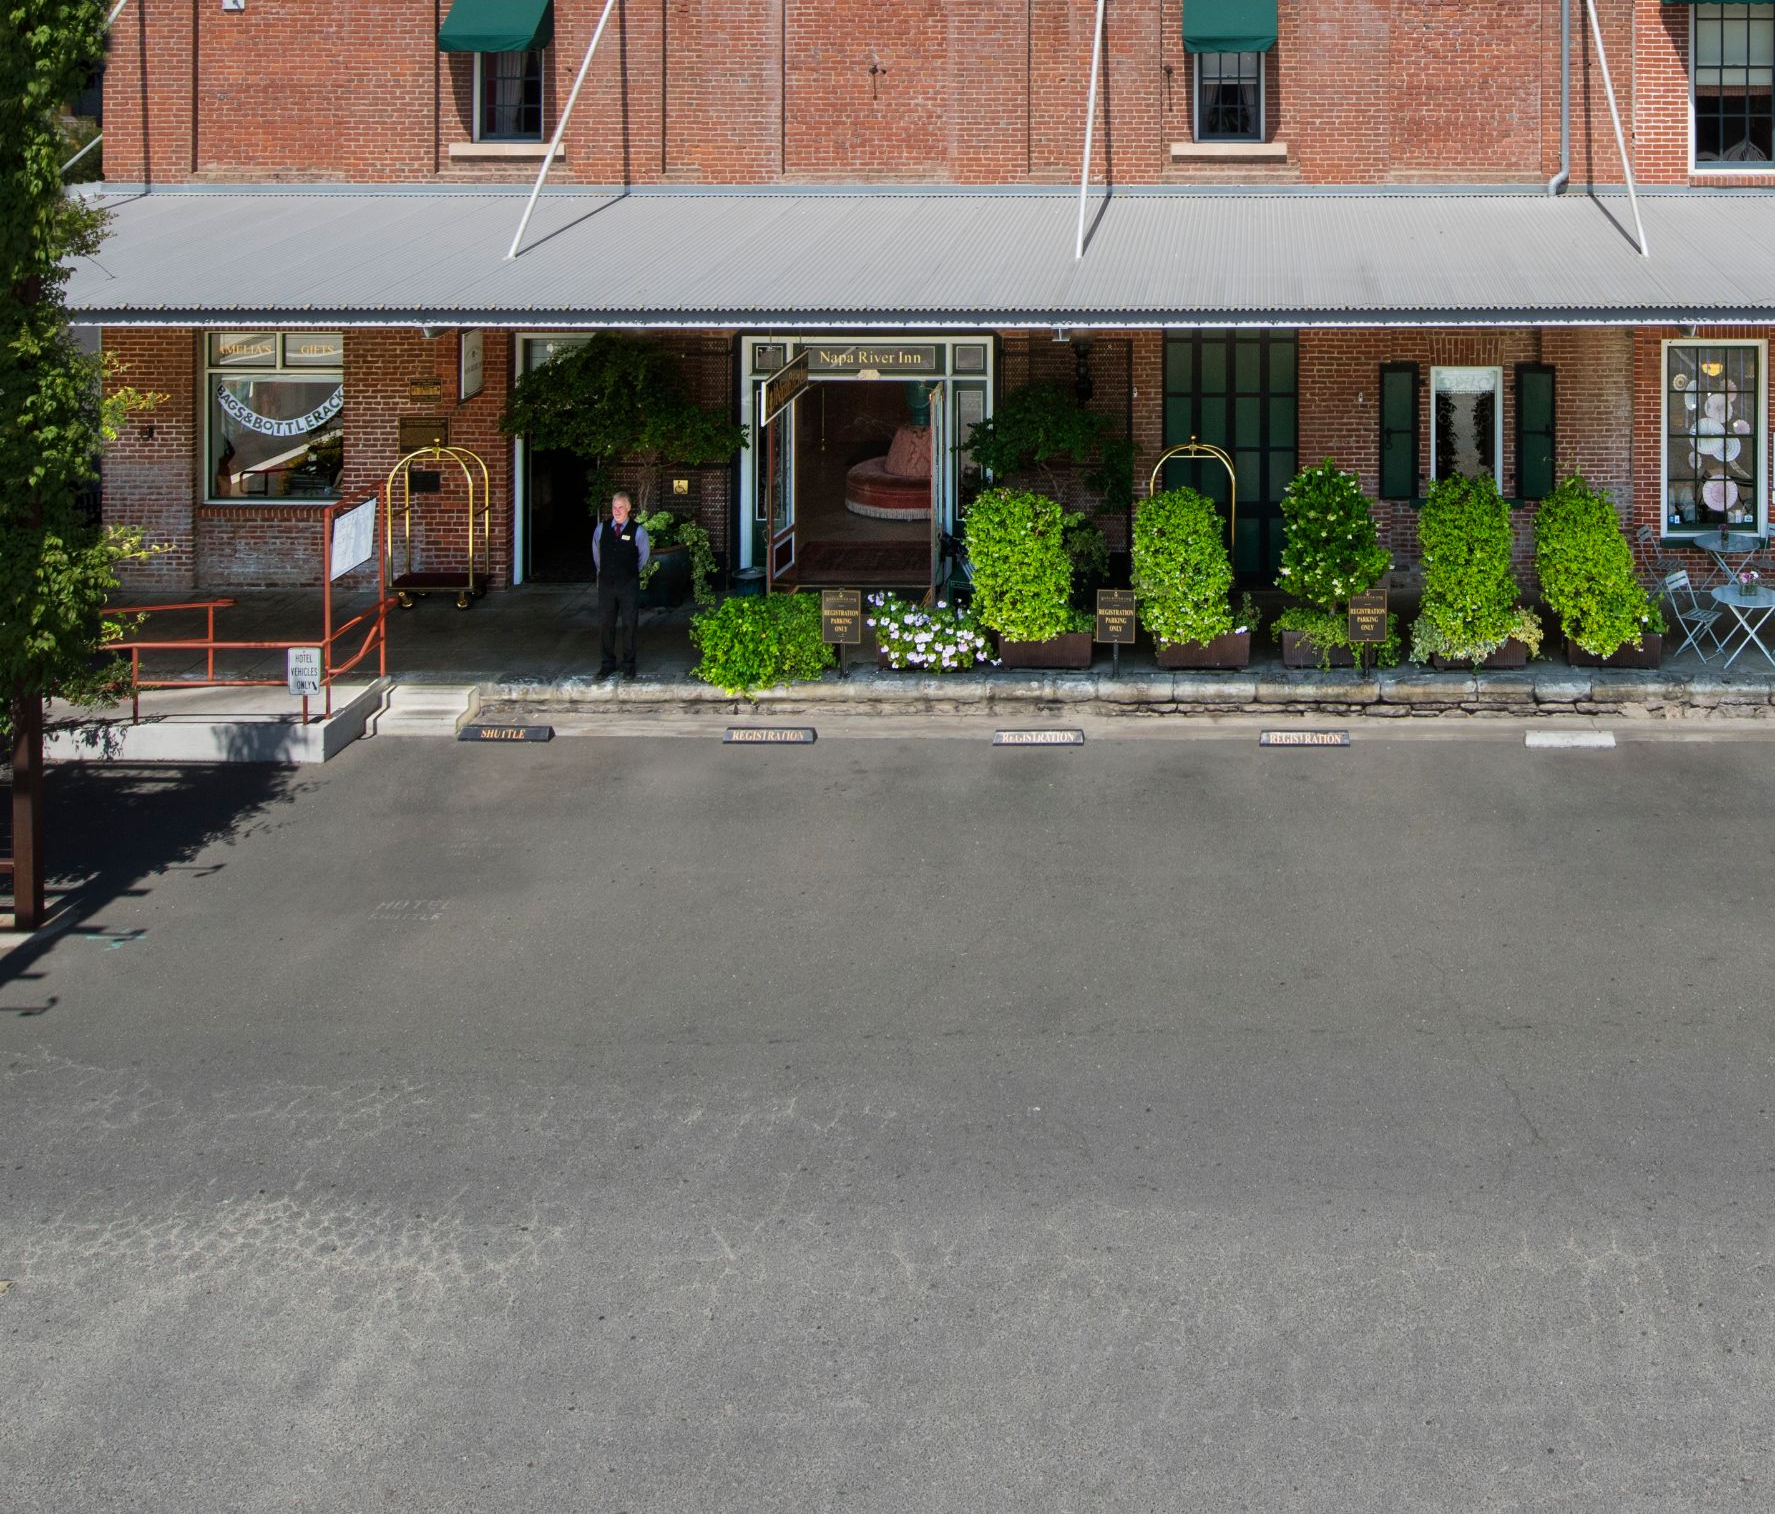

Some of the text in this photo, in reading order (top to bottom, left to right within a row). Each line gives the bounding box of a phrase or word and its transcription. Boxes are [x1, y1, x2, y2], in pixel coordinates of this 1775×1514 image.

[300, 344, 335, 355] GIFTS
[820, 351, 921, 367] Napa River Inn
[295, 654, 313, 663] HOTEL
[290, 667, 318, 676] VEHICLES
[296, 681, 313, 690] ONLY
[480, 728, 526, 739] SHUTTLE
[732, 730, 805, 741] REGISTRATION
[1002, 731, 1075, 743] REGISTRATION
[1269, 733, 1342, 744] REGISTRATION
